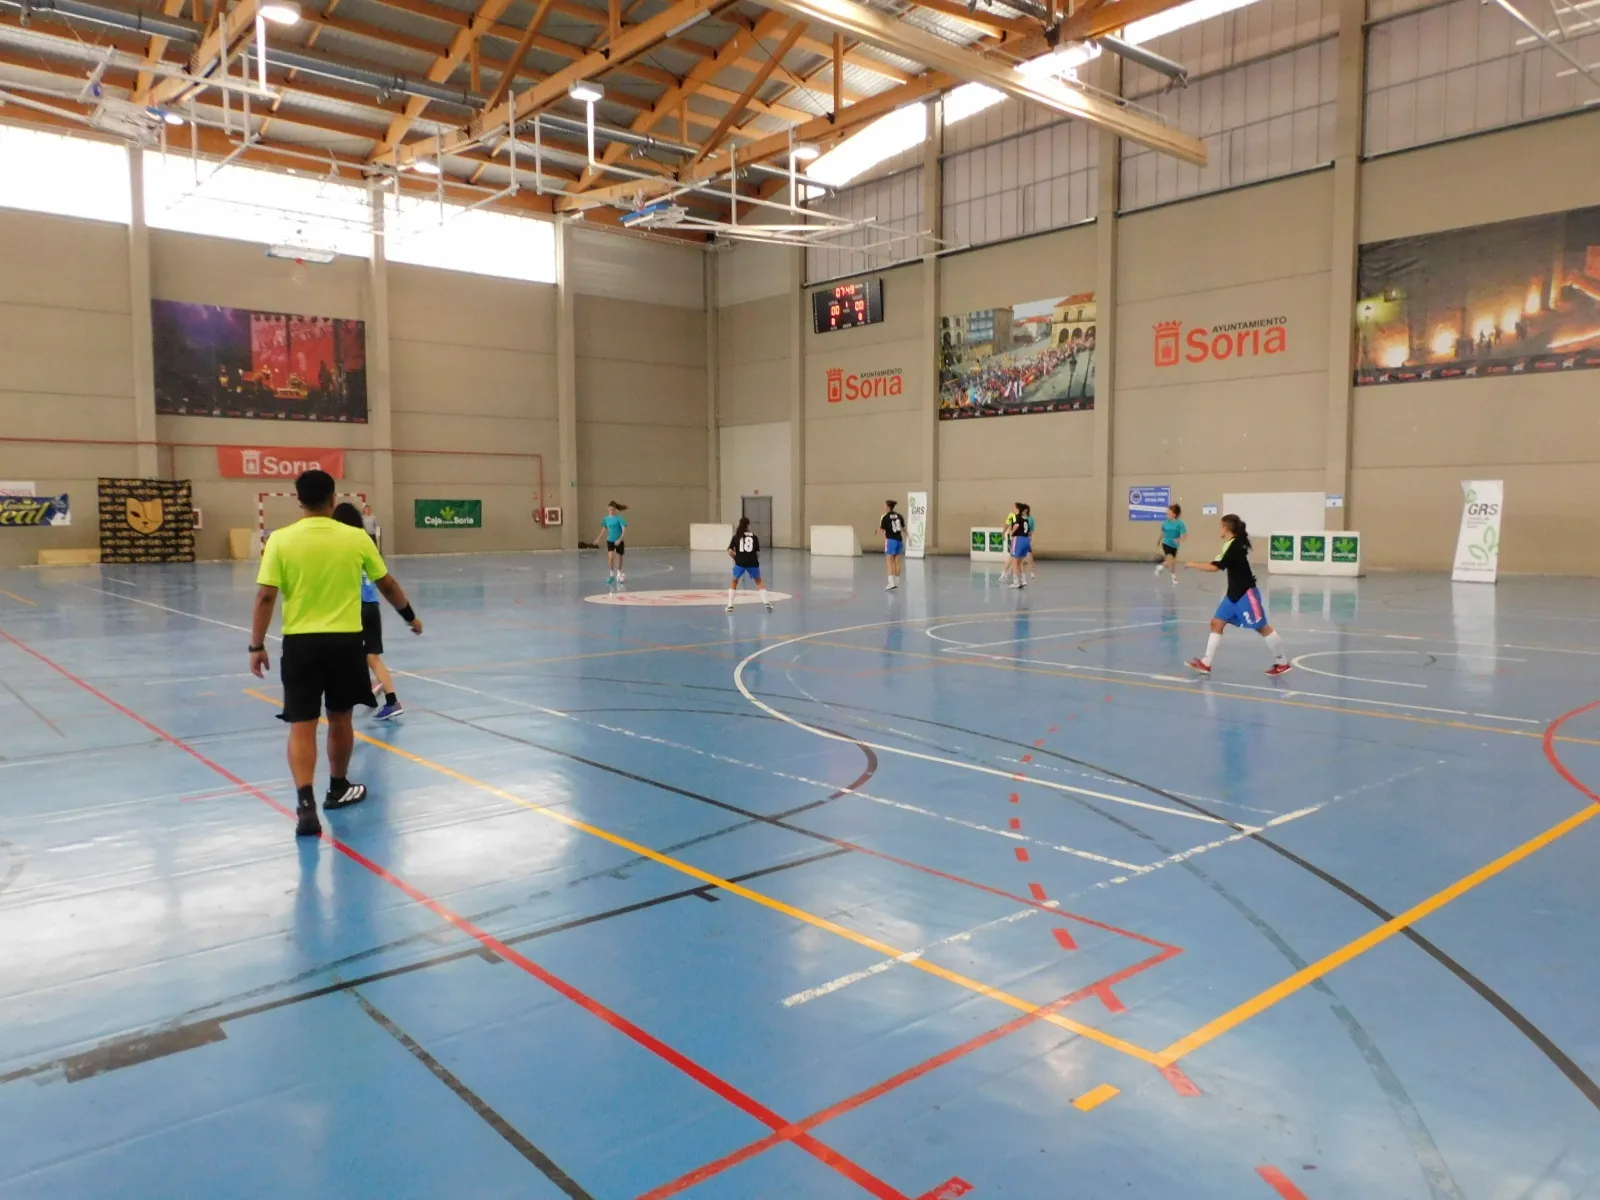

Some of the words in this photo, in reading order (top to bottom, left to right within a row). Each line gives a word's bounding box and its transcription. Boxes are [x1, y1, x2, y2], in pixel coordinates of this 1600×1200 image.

[1212, 316, 1287, 333] AYUNTAMIENTO
[1186, 325, 1287, 363] Soria
[860, 368, 903, 379] AYUNTAMIENTO
[845, 374, 903, 401] Soria
[911, 506, 925, 515] GRS
[1467, 503, 1499, 516] GRS
[424, 516, 442, 526] Caja
[453, 516, 474, 525] Soria
[739, 536, 754, 553] 18
